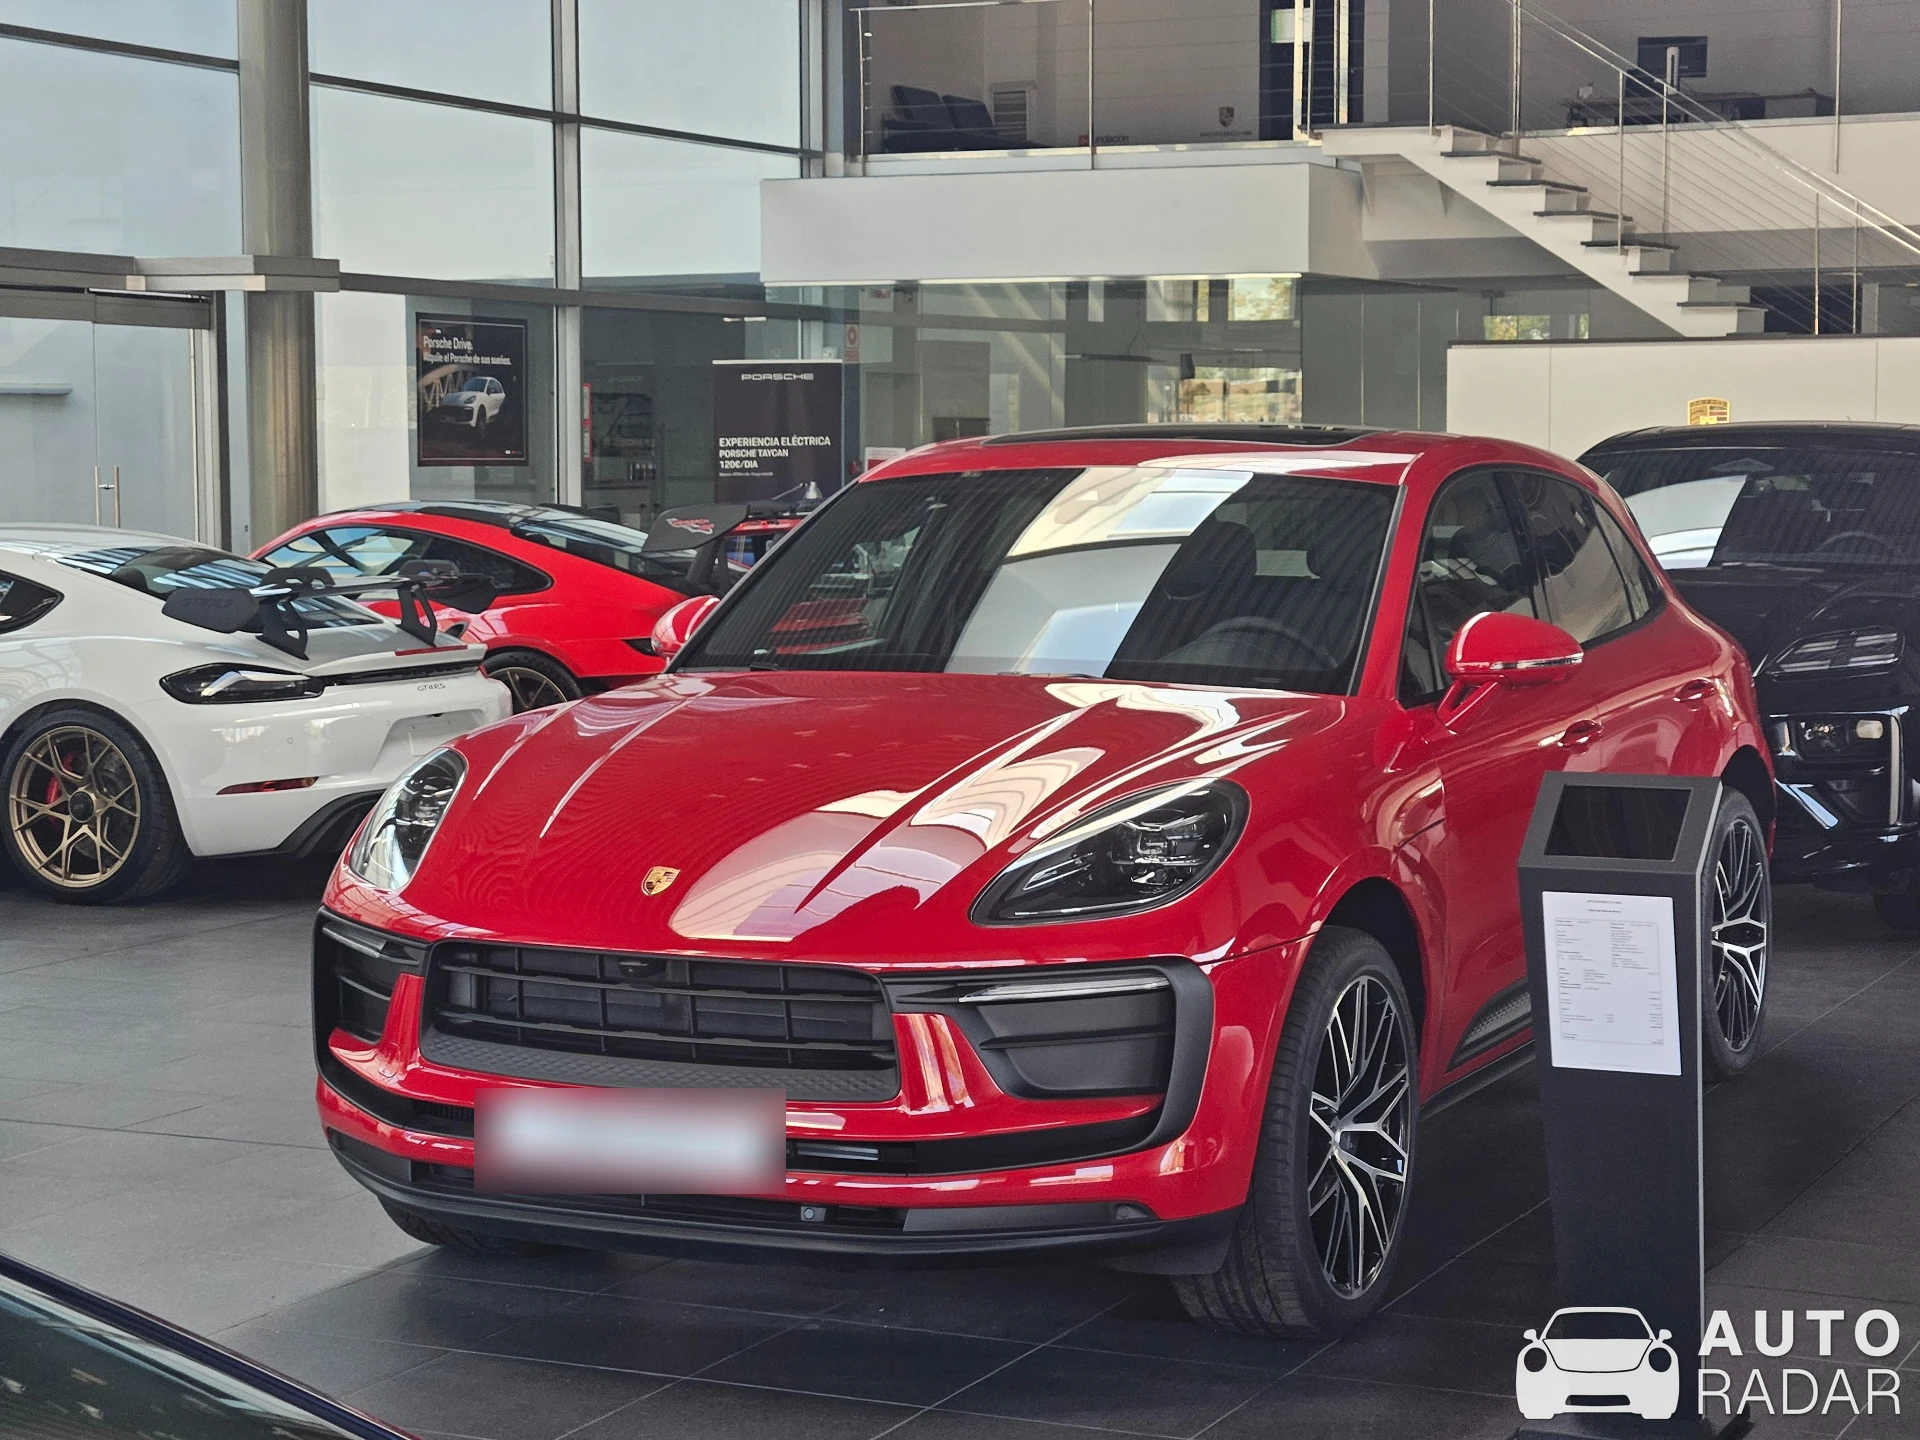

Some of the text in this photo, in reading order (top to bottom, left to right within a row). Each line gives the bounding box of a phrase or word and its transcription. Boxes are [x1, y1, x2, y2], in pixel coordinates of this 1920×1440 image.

[423, 335, 452, 349] Porsche
[450, 352, 472, 363] Porsche
[741, 372, 814, 381] PORSCHE
[719, 434, 831, 447] EXPERIENCIA ELÉCTRICA
[719, 448, 789, 458] PORSCHE TAYCAN
